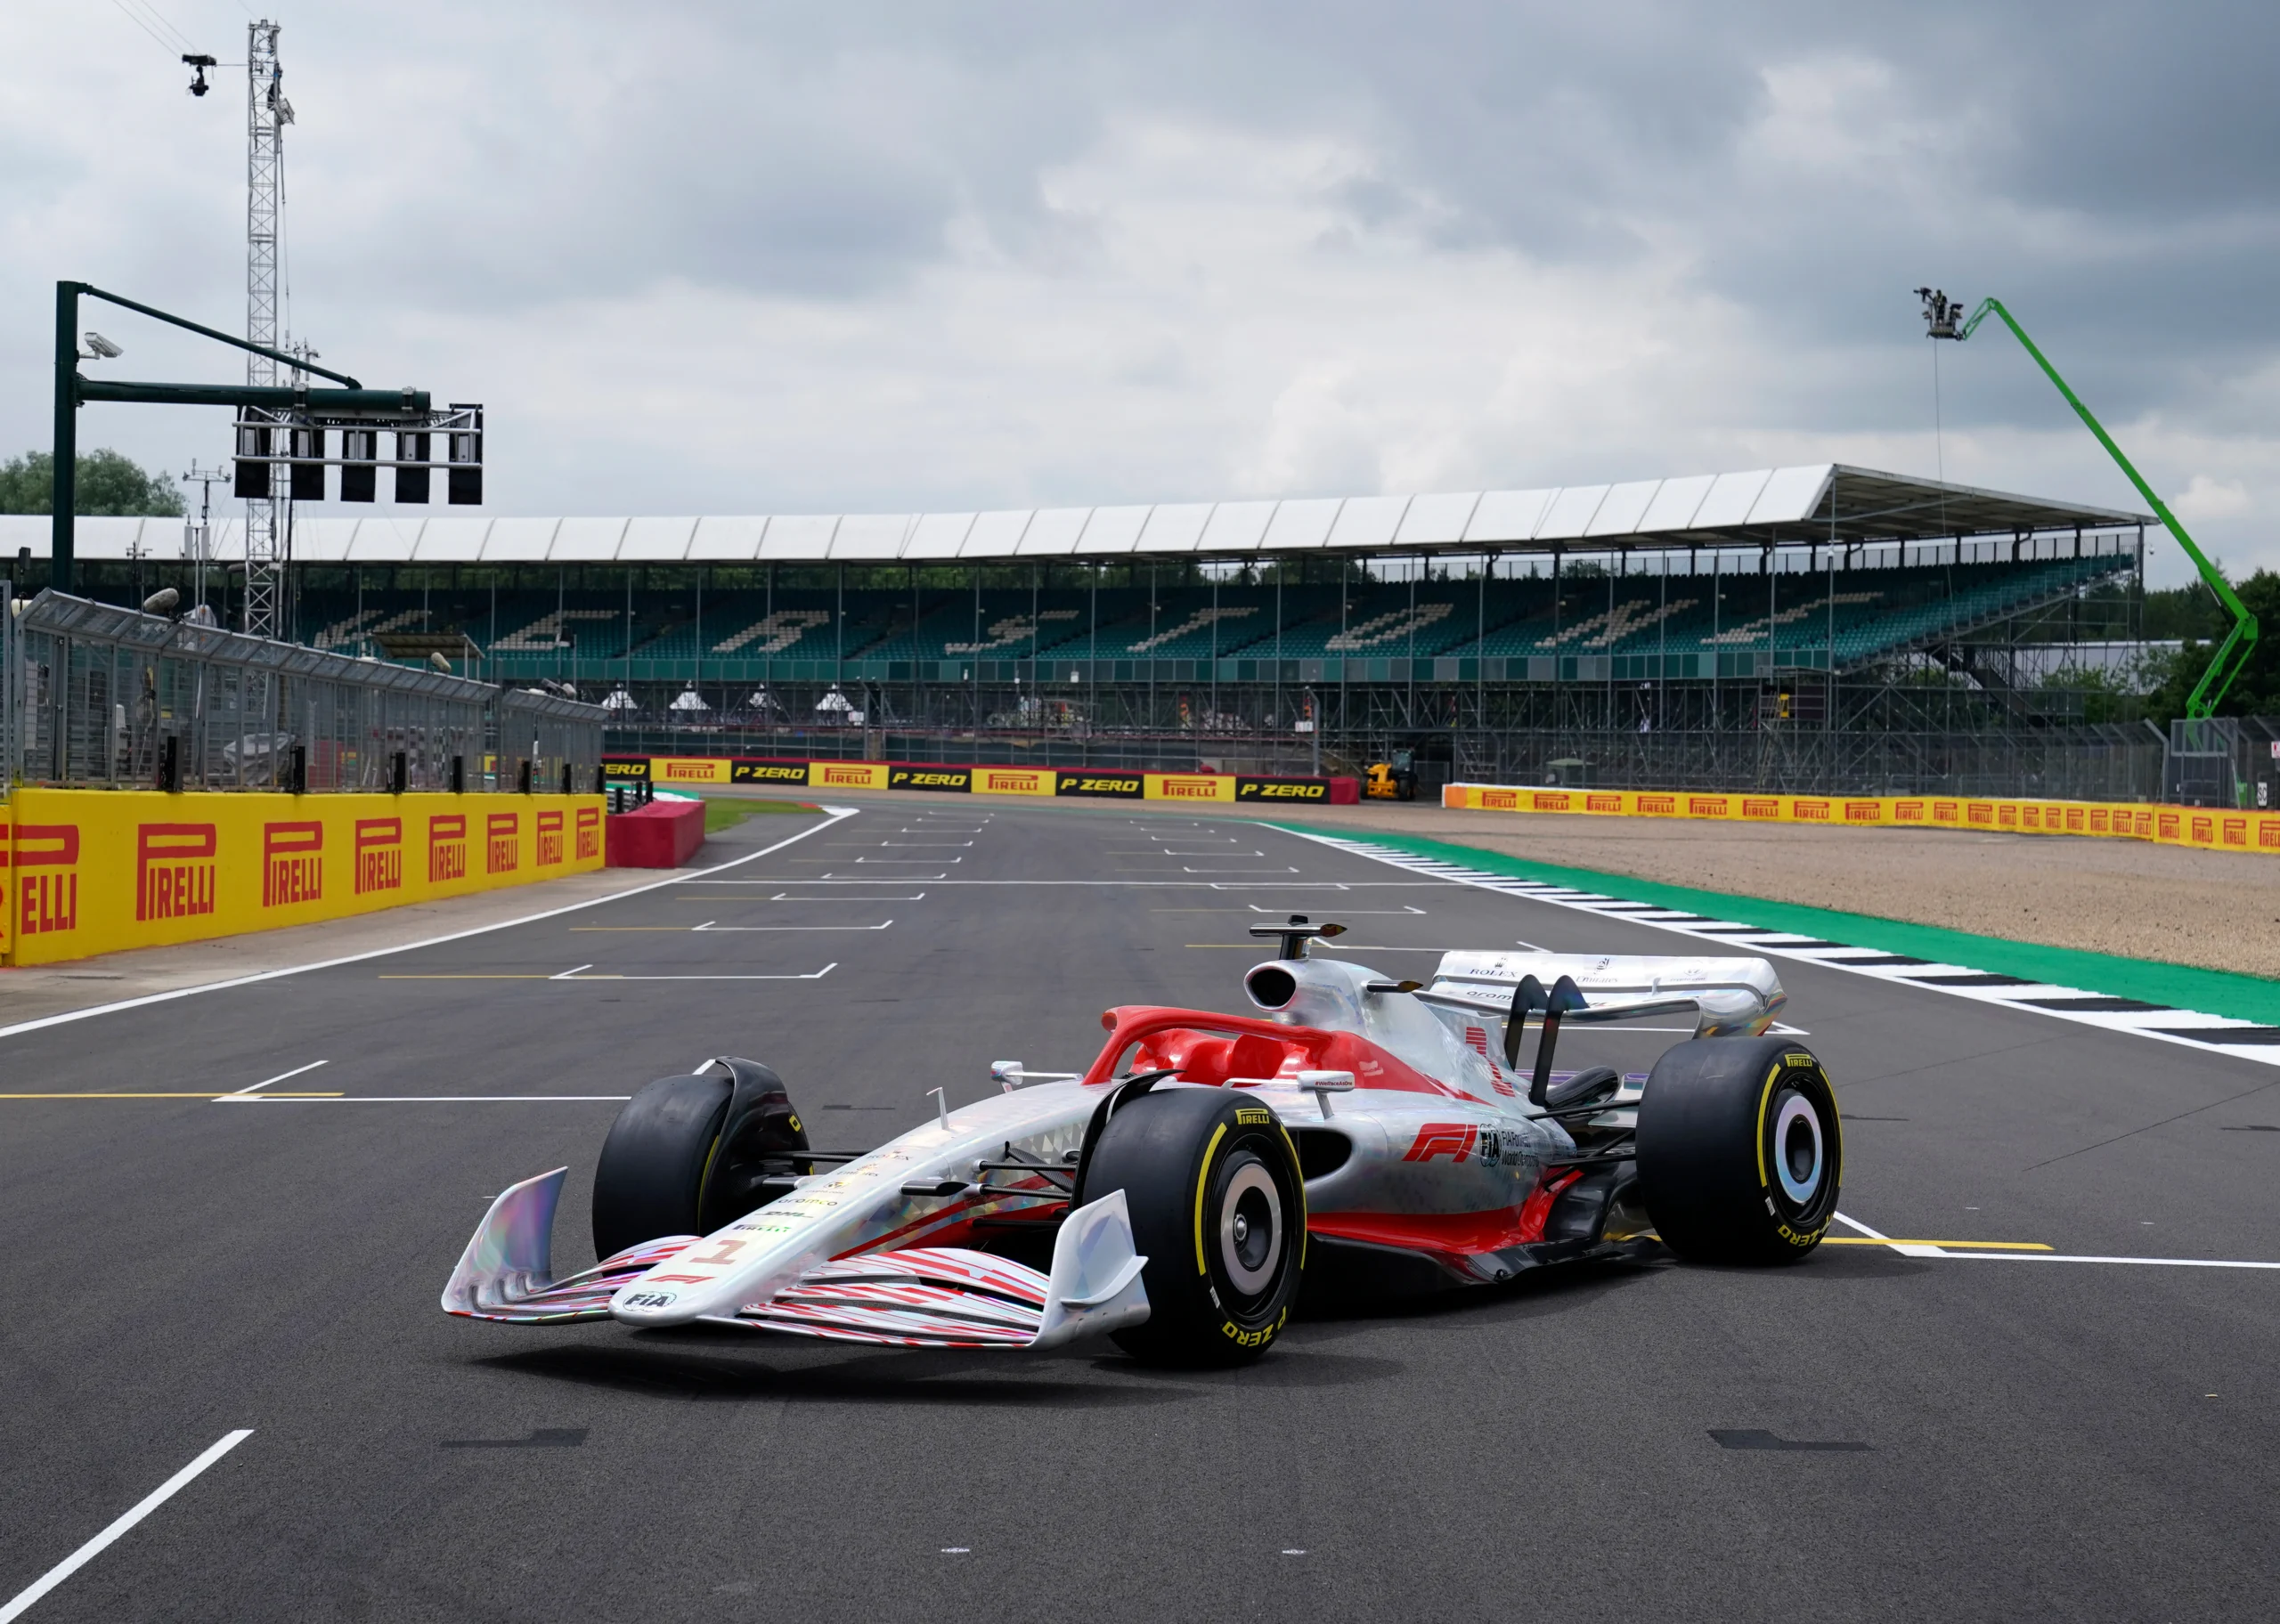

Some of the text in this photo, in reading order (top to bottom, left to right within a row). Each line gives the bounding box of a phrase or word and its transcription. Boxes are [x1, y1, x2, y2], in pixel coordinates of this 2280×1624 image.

[604, 763, 647, 775] ERO
[666, 763, 715, 779] PIRELLI
[735, 767, 805, 780] P ZERO
[824, 767, 872, 784] PIRELLI
[892, 772, 967, 786] P ZERO
[988, 774, 1039, 791] PIRELLI
[1060, 778, 1139, 792] P ZERO
[1162, 779, 1217, 797] PIRELLI
[1240, 784, 1325, 798] P ZERO
[1482, 792, 1517, 808] PIRELLI
[1534, 793, 1569, 810] PIRELLI
[1586, 795, 1621, 811] PIRELLI
[1637, 796, 1674, 813] PIRELLI
[1689, 798, 1728, 815] PIRELLI
[1742, 800, 1779, 816] PIRELLI
[1794, 801, 1829, 819] PIRELLI
[1845, 802, 1880, 820] PIRELLI
[1895, 802, 1924, 820] PIRELLI
[1934, 802, 1958, 821] PIRELLI
[1968, 804, 1992, 824] PIRELLI
[1999, 806, 2016, 825] PIRELLI
[2024, 807, 2039, 827] PIRELLI
[2066, 808, 2084, 830] PIRELLI
[2090, 809, 2107, 832] PIRELLI
[2113, 810, 2132, 833] PIRELLI
[2159, 814, 2180, 839] PIRELLI
[2192, 816, 2213, 843] PIRELLI
[537, 811, 563, 865] PIRELLI
[576, 808, 598, 860] PIRELLI
[2224, 819, 2246, 845] PIRELLI
[429, 815, 466, 882] PIRELLI
[487, 813, 517, 873] PIRELLI
[263, 821, 323, 907] PIRELLI
[354, 817, 402, 895] PIRELLI
[0, 824, 79, 935] PELLI
[136, 823, 216, 922] PIRELLI
[1470, 968, 1518, 978] ROLEX
[1576, 975, 1618, 983] Emirates
[1467, 990, 1512, 1001] aram
[1784, 1053, 1813, 1068] PIRELLI
[1234, 1108, 1270, 1125] PIRELLI
[1401, 1123, 1478, 1163] F1
[778, 1198, 838, 1206] aramco
[1777, 1224, 1820, 1247] ZERO
[689, 1240, 745, 1264] 1
[1221, 1304, 1287, 1347] P ZERO
